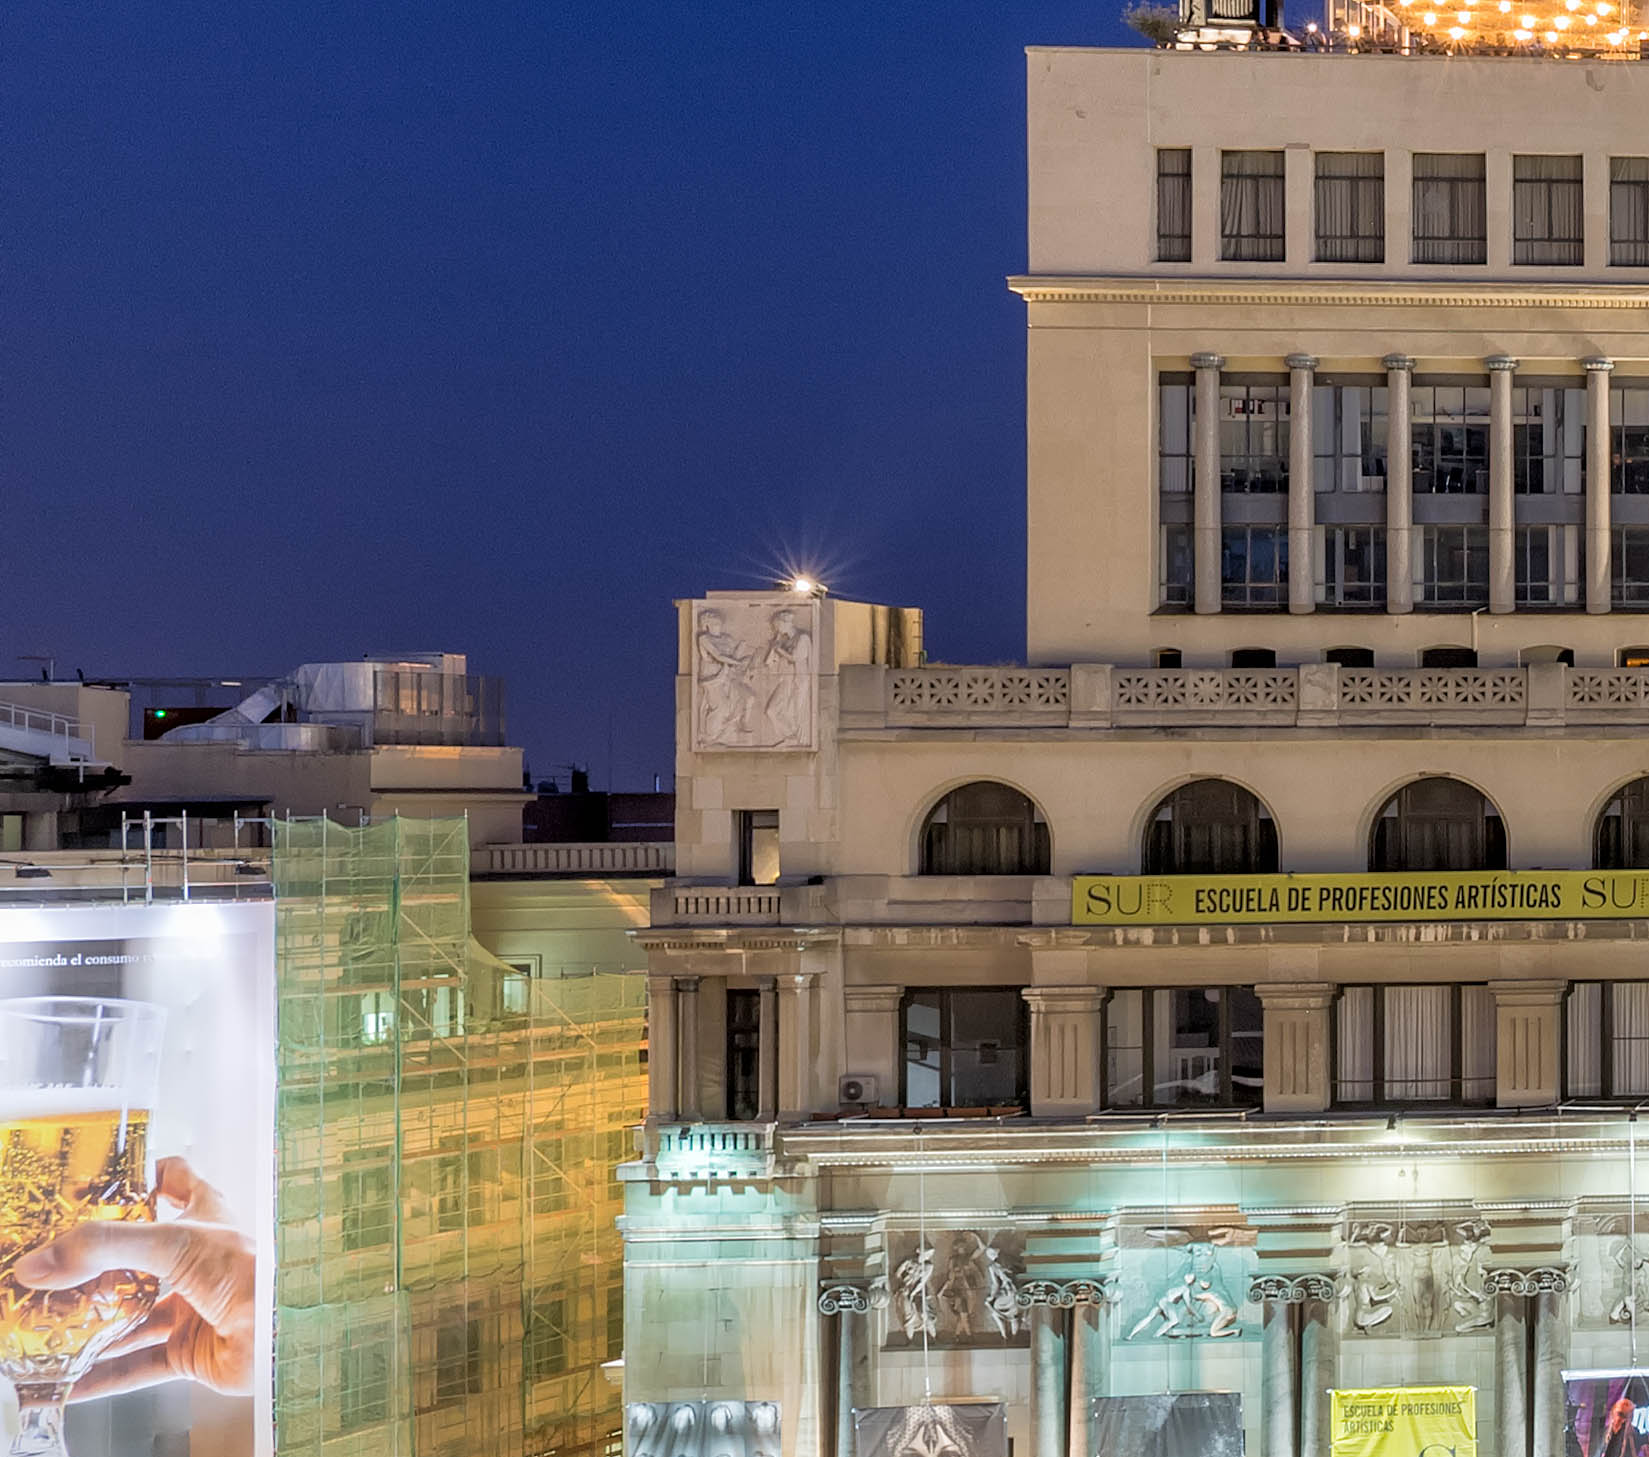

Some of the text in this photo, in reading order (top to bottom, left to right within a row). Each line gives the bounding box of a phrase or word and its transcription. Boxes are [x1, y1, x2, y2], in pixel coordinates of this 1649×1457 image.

[1085, 882, 1174, 915] SUR
[1194, 876, 1562, 913] ESCUELA DE PROFESIONES ARTÍSTICAS
[70, 953, 82, 967] el
[85, 950, 139, 966] consumo
[1343, 1401, 1463, 1419] ESCUELA DE PROFESIONES
[1343, 1418, 1394, 1434] ARTÍSTICAS
